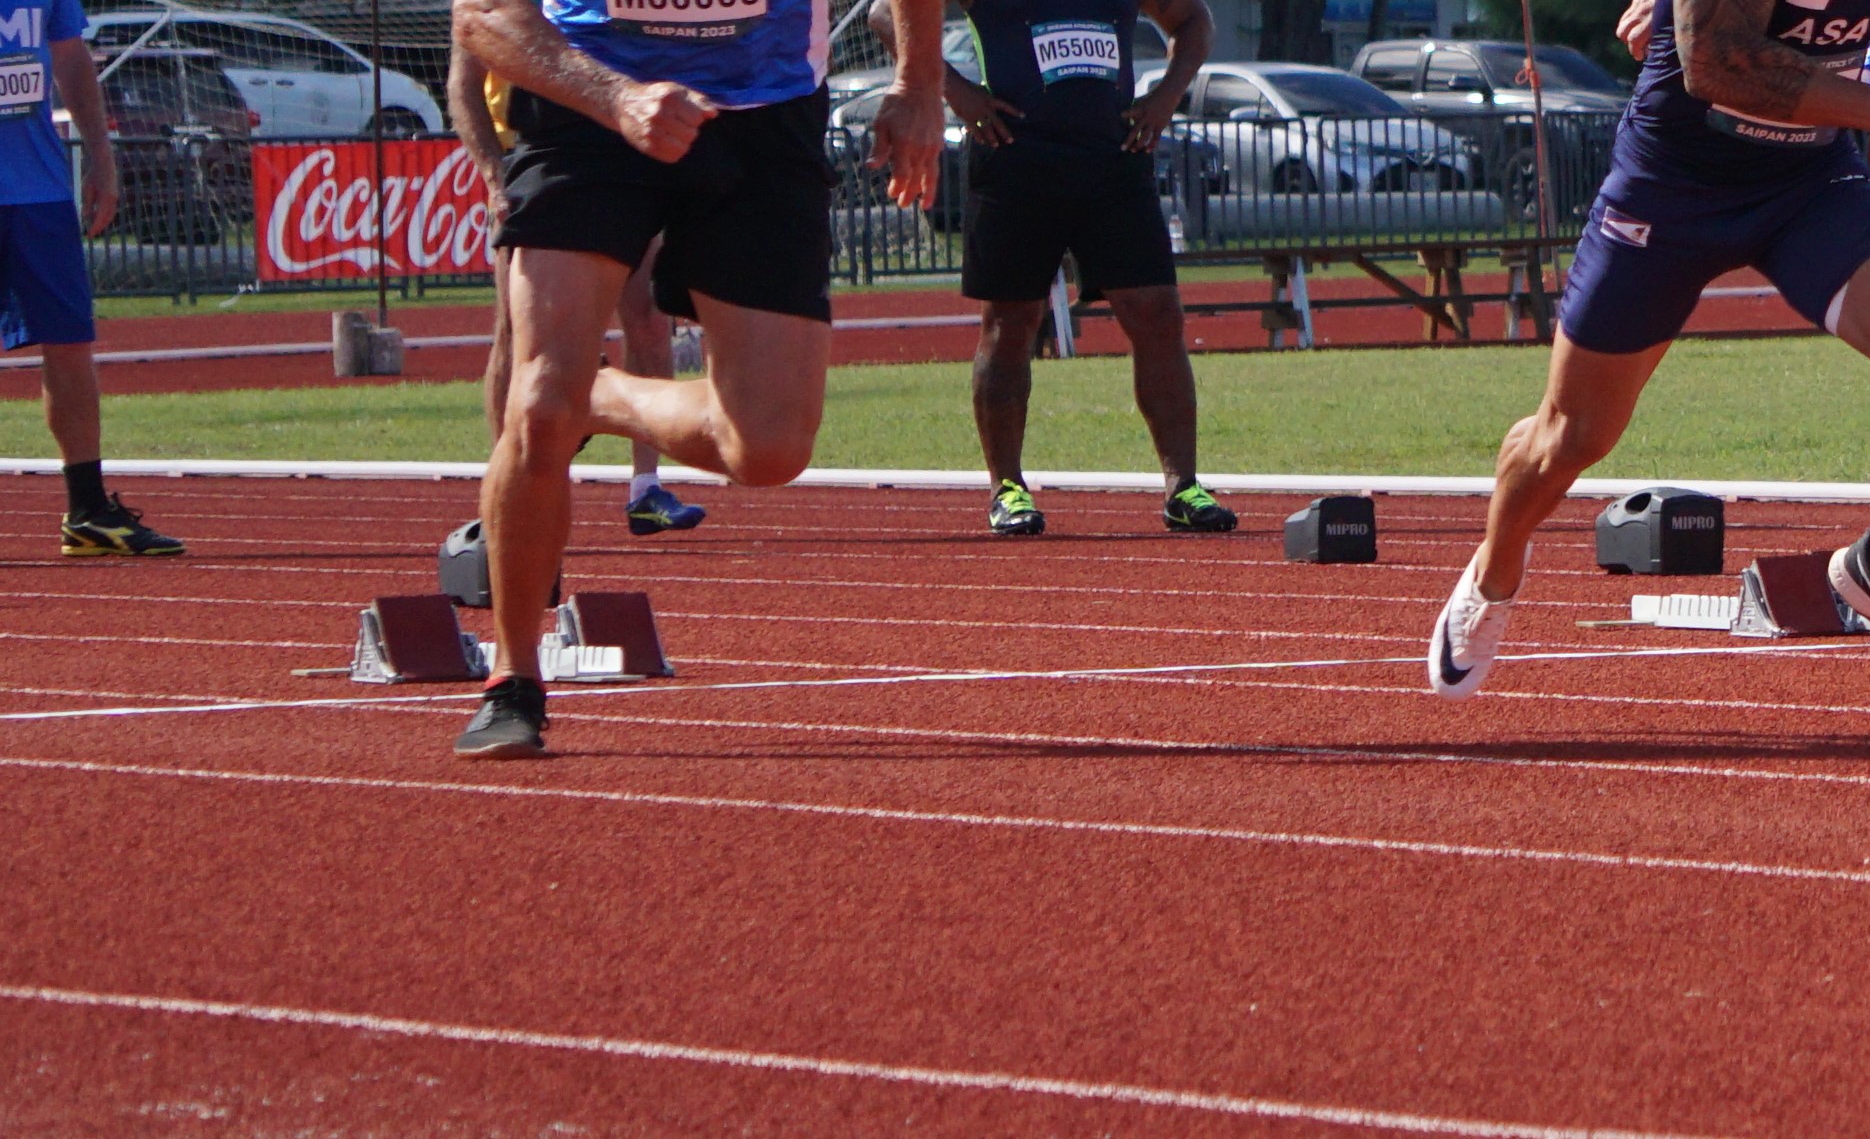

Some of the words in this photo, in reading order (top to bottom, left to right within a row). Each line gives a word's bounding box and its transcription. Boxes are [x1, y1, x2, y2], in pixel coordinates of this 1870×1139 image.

[0, 8, 42, 48] MI
[643, 25, 697, 37] SAIPAN
[701, 25, 736, 37] 2023
[1778, 17, 1870, 45] ASA
[1038, 38, 1117, 63] M55002
[0, 71, 41, 97] 0007
[1735, 124, 1786, 142] SAIPAN
[1787, 132, 1817, 142] 2023
[267, 146, 497, 273] Coca-Co
[1326, 523, 1369, 535] MIPRO
[1672, 515, 1715, 530] MIPRO
